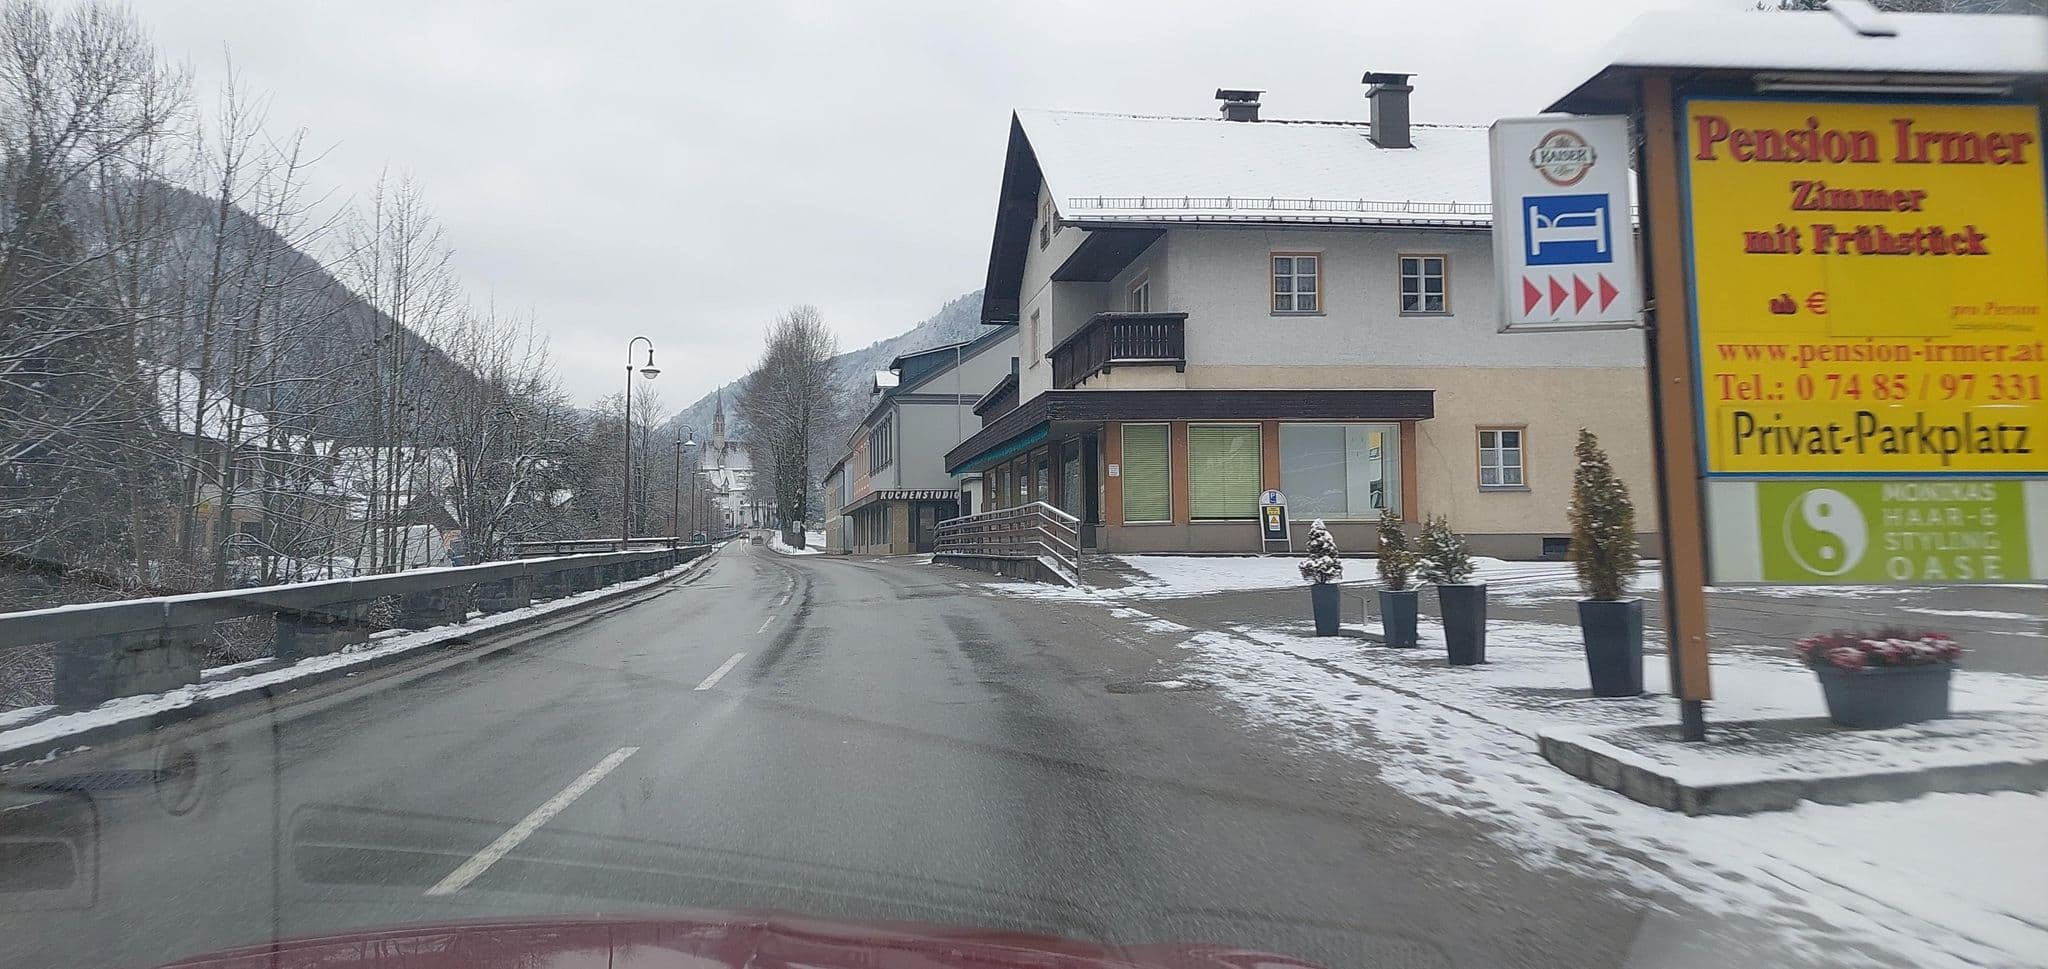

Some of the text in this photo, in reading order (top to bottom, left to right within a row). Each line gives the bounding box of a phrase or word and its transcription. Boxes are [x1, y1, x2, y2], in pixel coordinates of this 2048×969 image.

[1694, 114, 2033, 165] Pension Irmer
[1790, 180, 1928, 212] Zimmer
[1744, 223, 1989, 256] mit Frühstück
[1769, 293, 1798, 315] ab
[1716, 337, 2045, 369] www.pension-irmer.at
[1714, 373, 1784, 401] Tel.:
[1797, 374, 1814, 401] 0
[1825, 374, 1862, 401] 74
[1871, 374, 1909, 401] 85
[1939, 374, 1977, 401] 97
[1987, 373, 2042, 401] 331
[1733, 410, 2032, 466] Privat-Parkplatz
[1886, 555, 2006, 580] OASE
